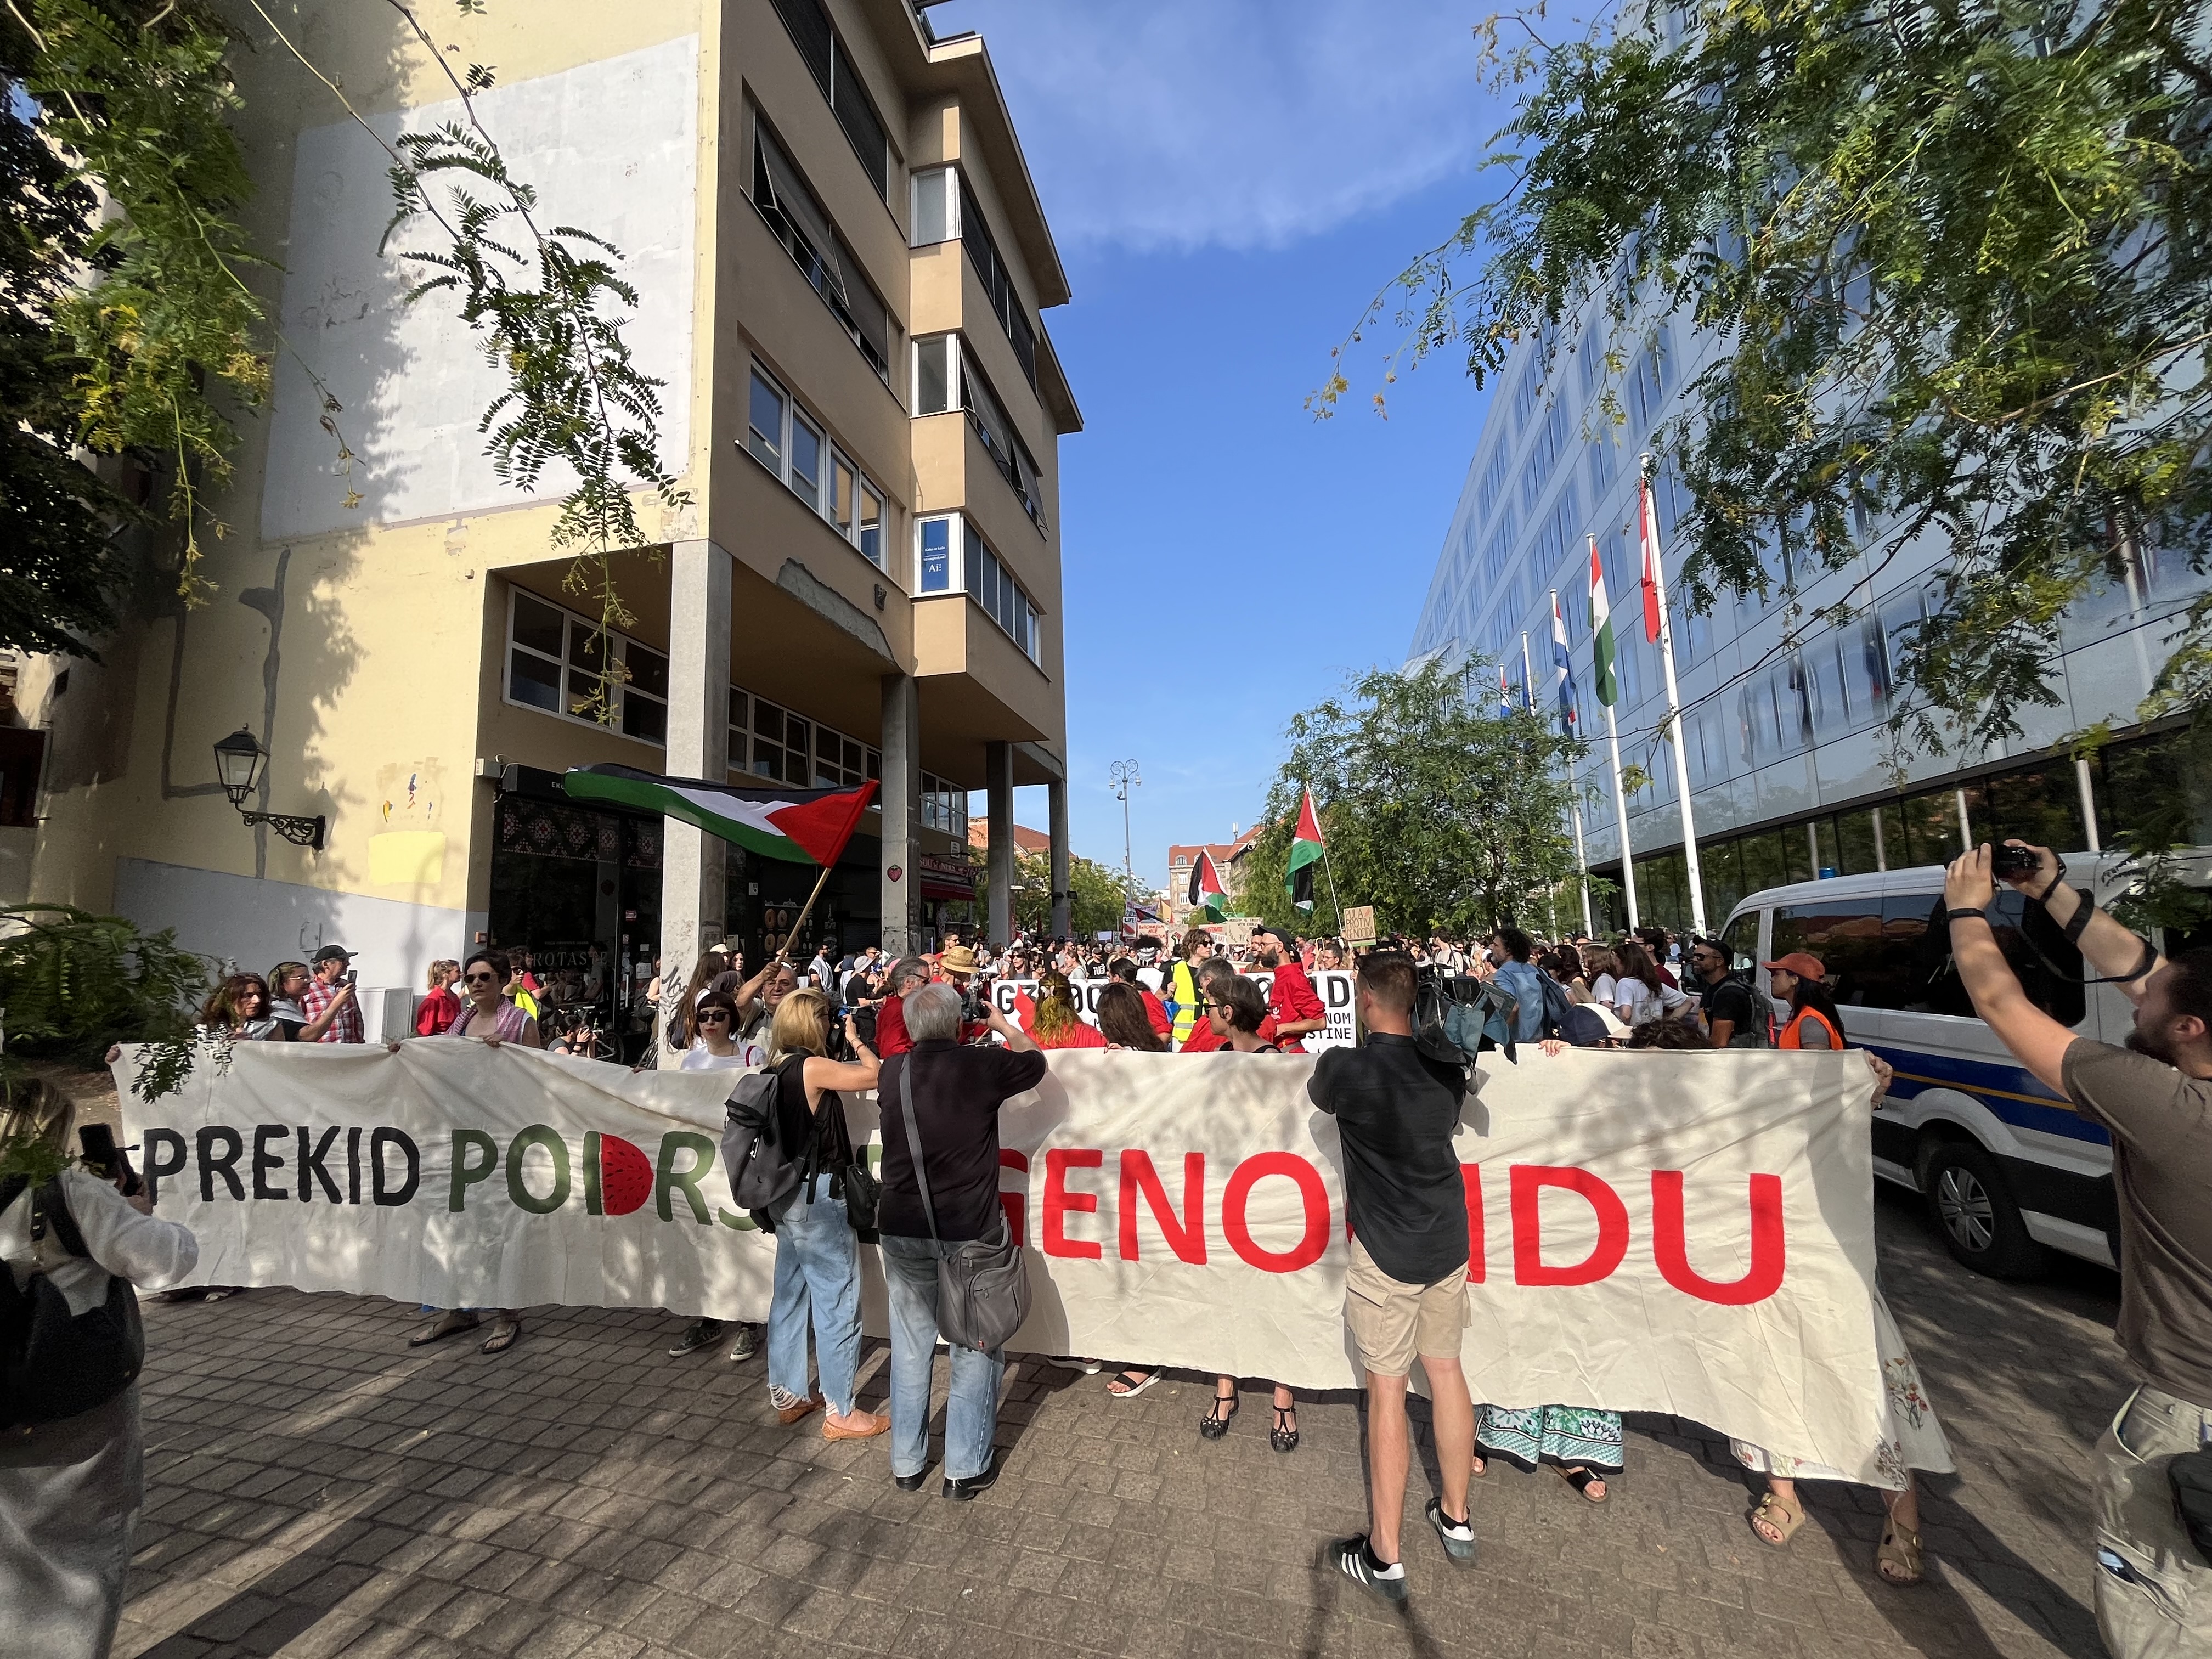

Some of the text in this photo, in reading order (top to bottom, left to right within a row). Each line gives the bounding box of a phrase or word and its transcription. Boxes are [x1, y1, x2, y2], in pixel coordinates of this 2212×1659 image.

[1345, 909, 1364, 919] PULA
[1346, 917, 1371, 929] PROTIV
[533, 951, 607, 967] ROTASE
[1325, 1012, 1351, 1024] NOM
[1308, 1028, 1352, 1039] STINE
[143, 1124, 420, 1207] PREKID
[998, 1147, 1786, 1305] ENOIDU
